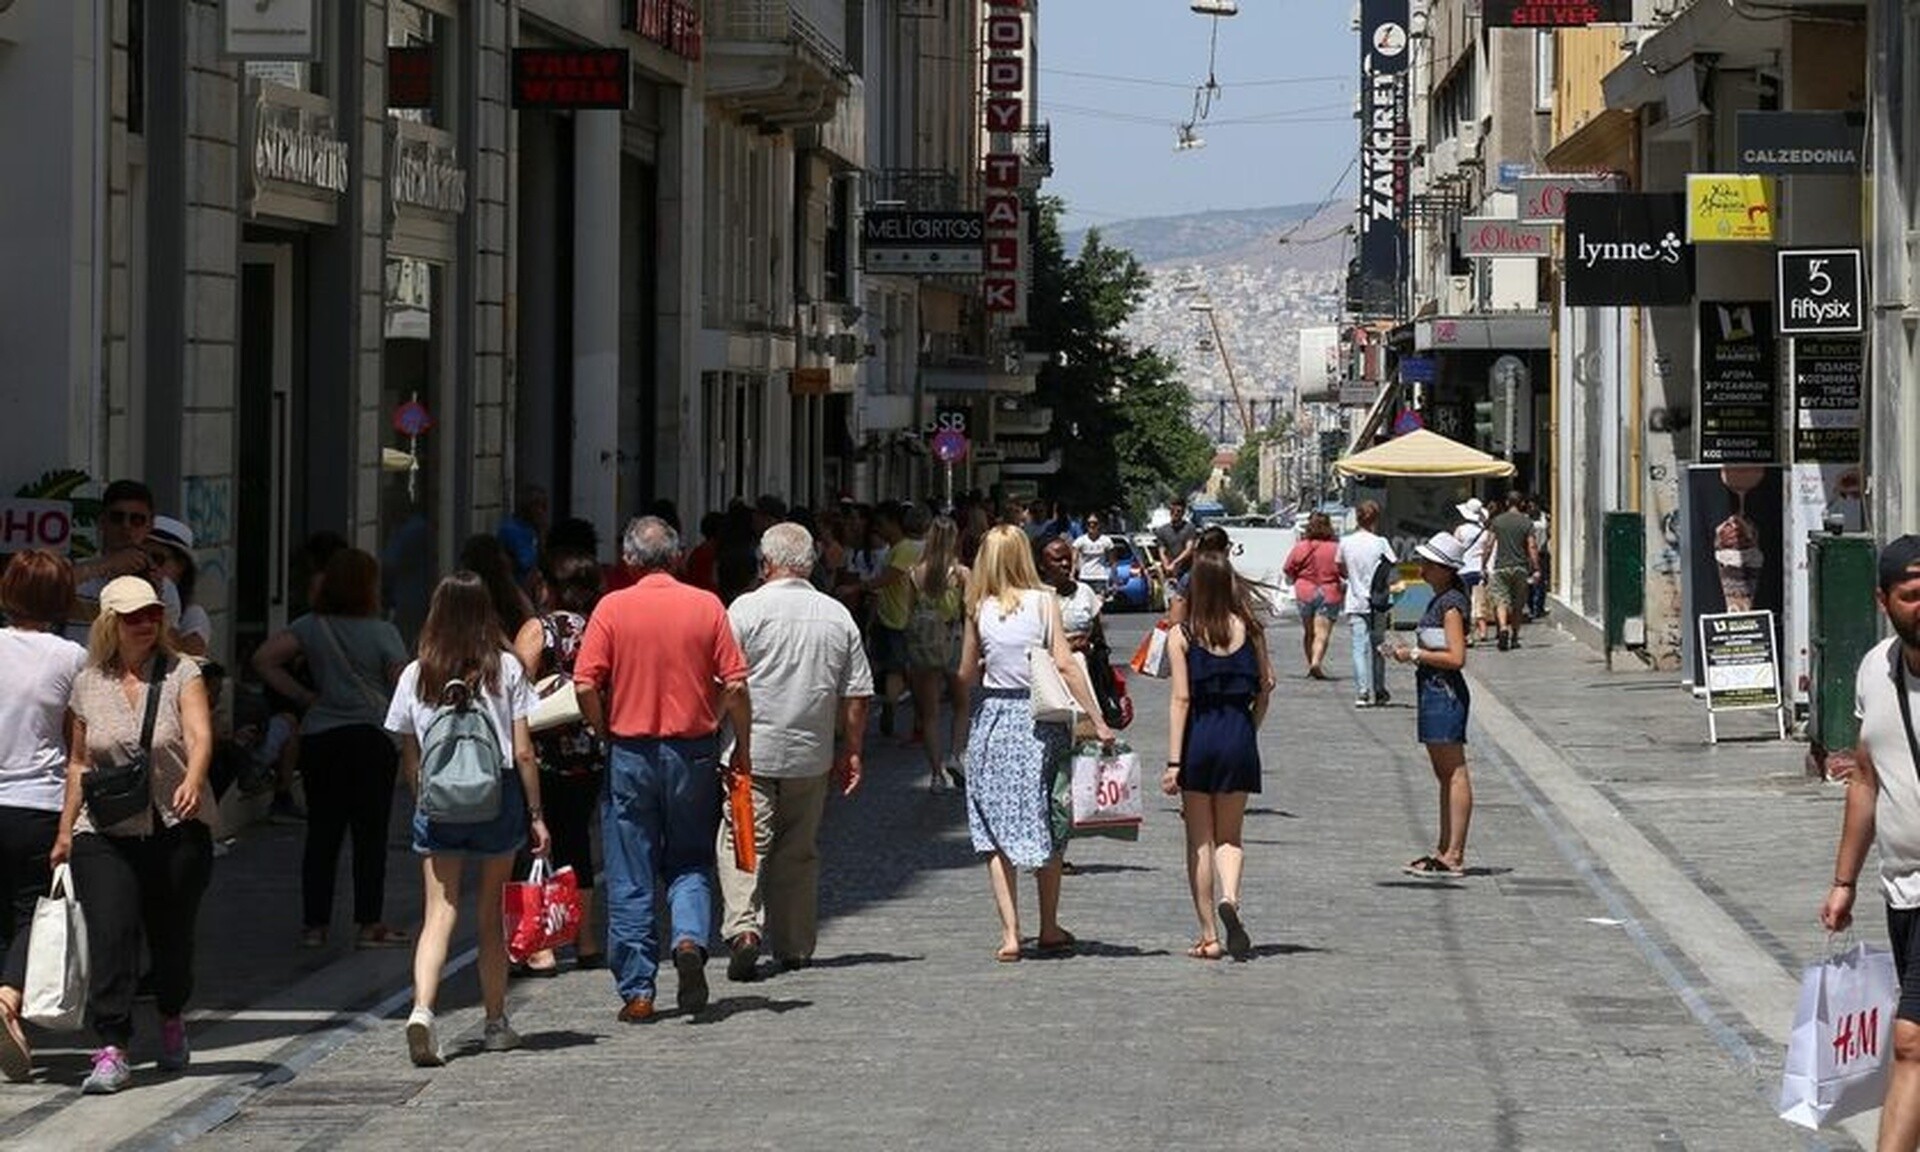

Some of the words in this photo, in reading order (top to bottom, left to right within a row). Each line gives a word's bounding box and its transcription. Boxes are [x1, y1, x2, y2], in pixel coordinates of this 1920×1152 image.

[990, 20, 1021, 127] ODY
[1743, 149, 1857, 164] CALZEDONIA
[986, 160, 1018, 306] TALK
[1578, 232, 1660, 268] lynne
[1791, 297, 1851, 324] fiftysix
[0, 510, 69, 545] HO
[1833, 1006, 1878, 1065] H&M
